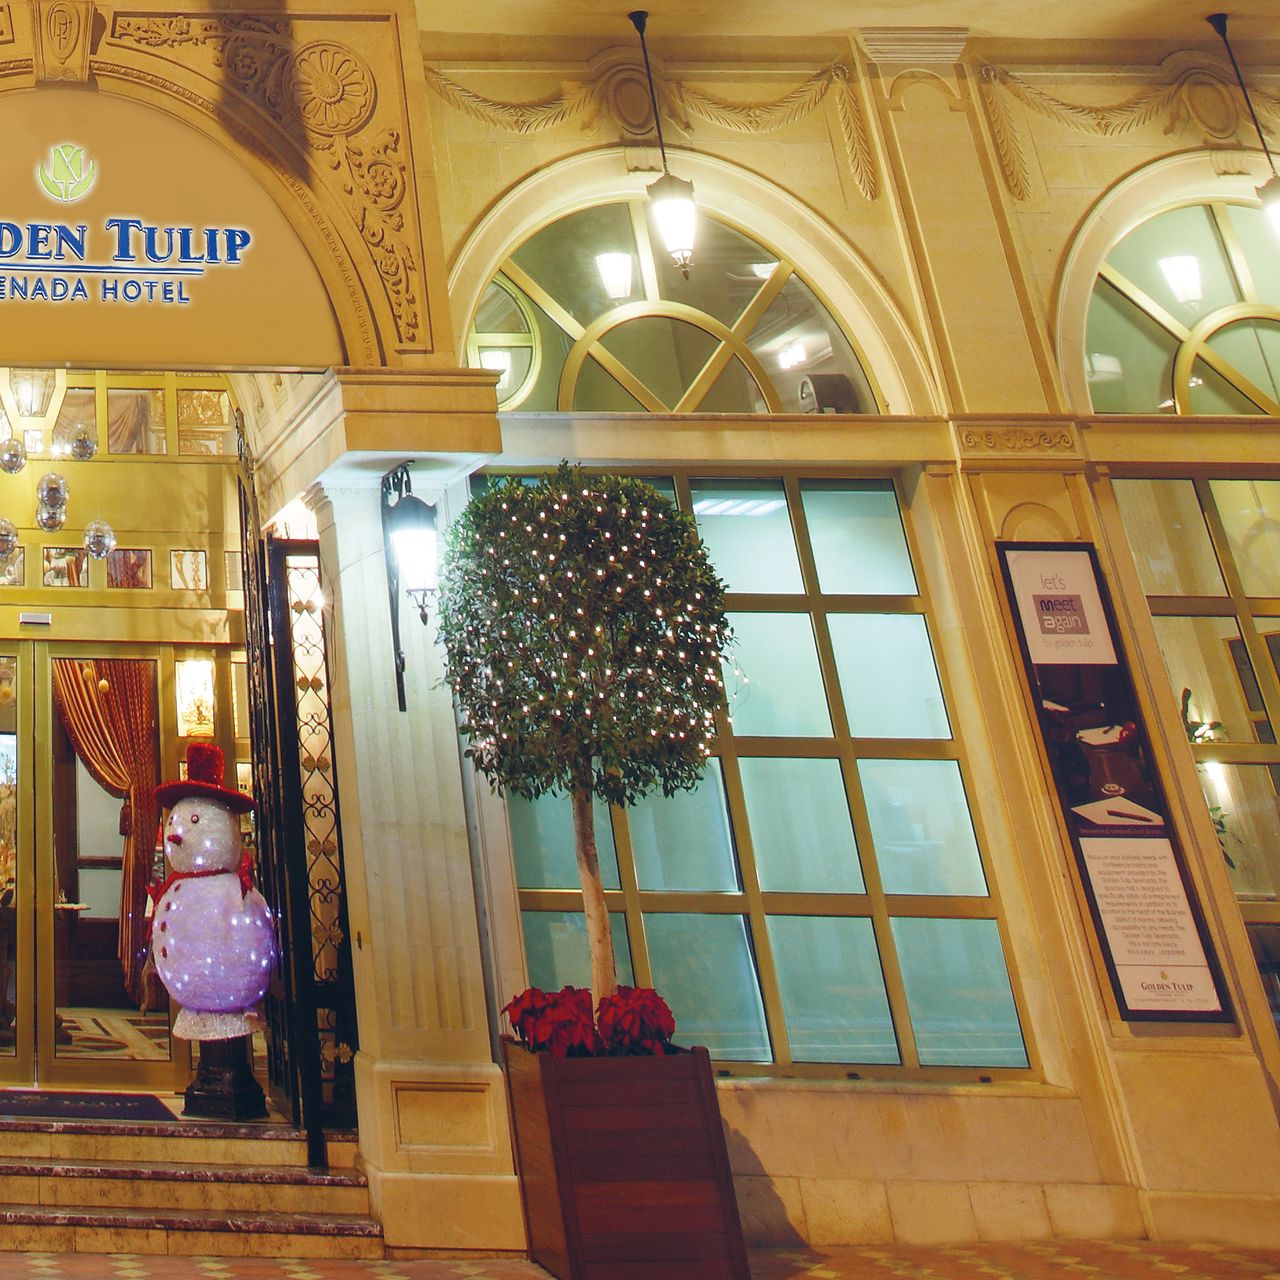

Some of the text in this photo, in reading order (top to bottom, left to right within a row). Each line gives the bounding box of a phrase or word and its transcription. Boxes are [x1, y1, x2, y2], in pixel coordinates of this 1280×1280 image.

[105, 218, 252, 264] TULIP
[102, 279, 190, 304] HOTEL
[1040, 572, 1067, 590] let's
[1042, 611, 1082, 633] again
[1140, 982, 1194, 992] GOLDEN TULIP
